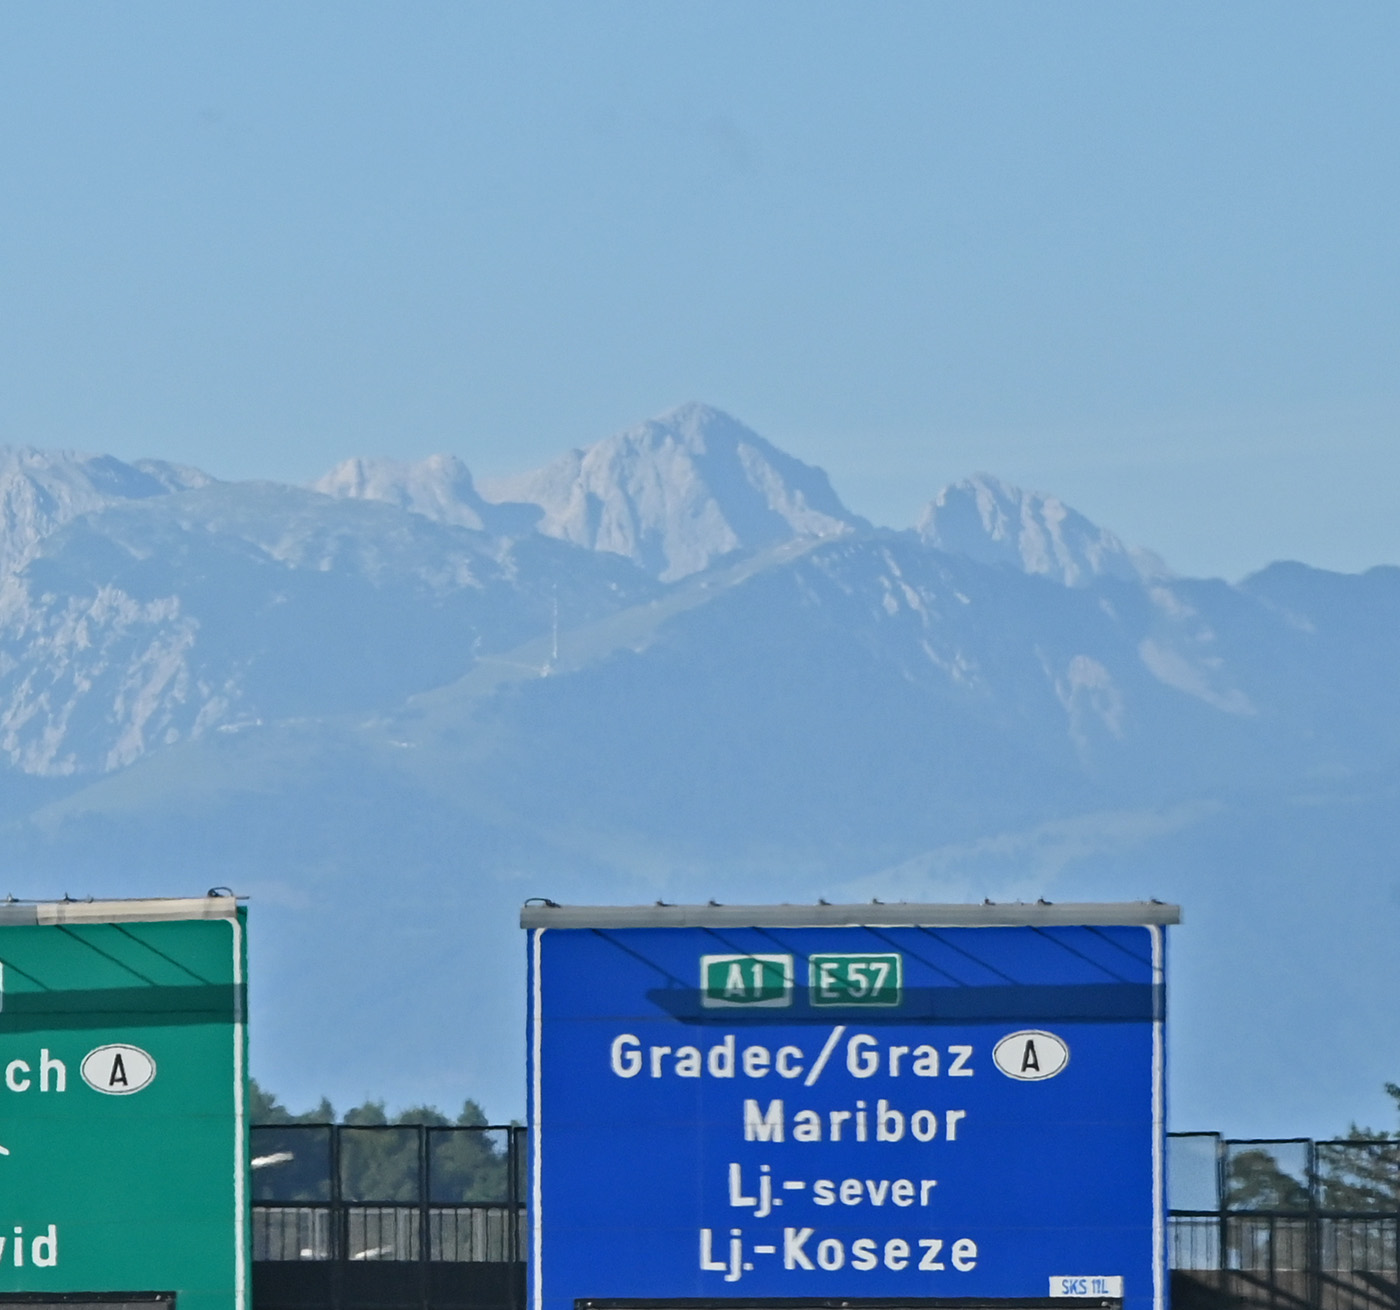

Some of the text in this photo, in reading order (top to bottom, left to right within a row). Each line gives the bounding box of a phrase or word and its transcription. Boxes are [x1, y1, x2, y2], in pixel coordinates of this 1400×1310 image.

[723, 964, 765, 998] A1
[819, 962, 892, 998] E 57
[107, 1053, 130, 1087] A
[610, 1025, 1041, 1087] Gradec/Graz A
[743, 1098, 967, 1142] Maribor
[728, 1162, 939, 1218] Lj.-sever
[699, 1227, 979, 1282] Lj.-Koseze
[1062, 1279, 1087, 1295] SKS
